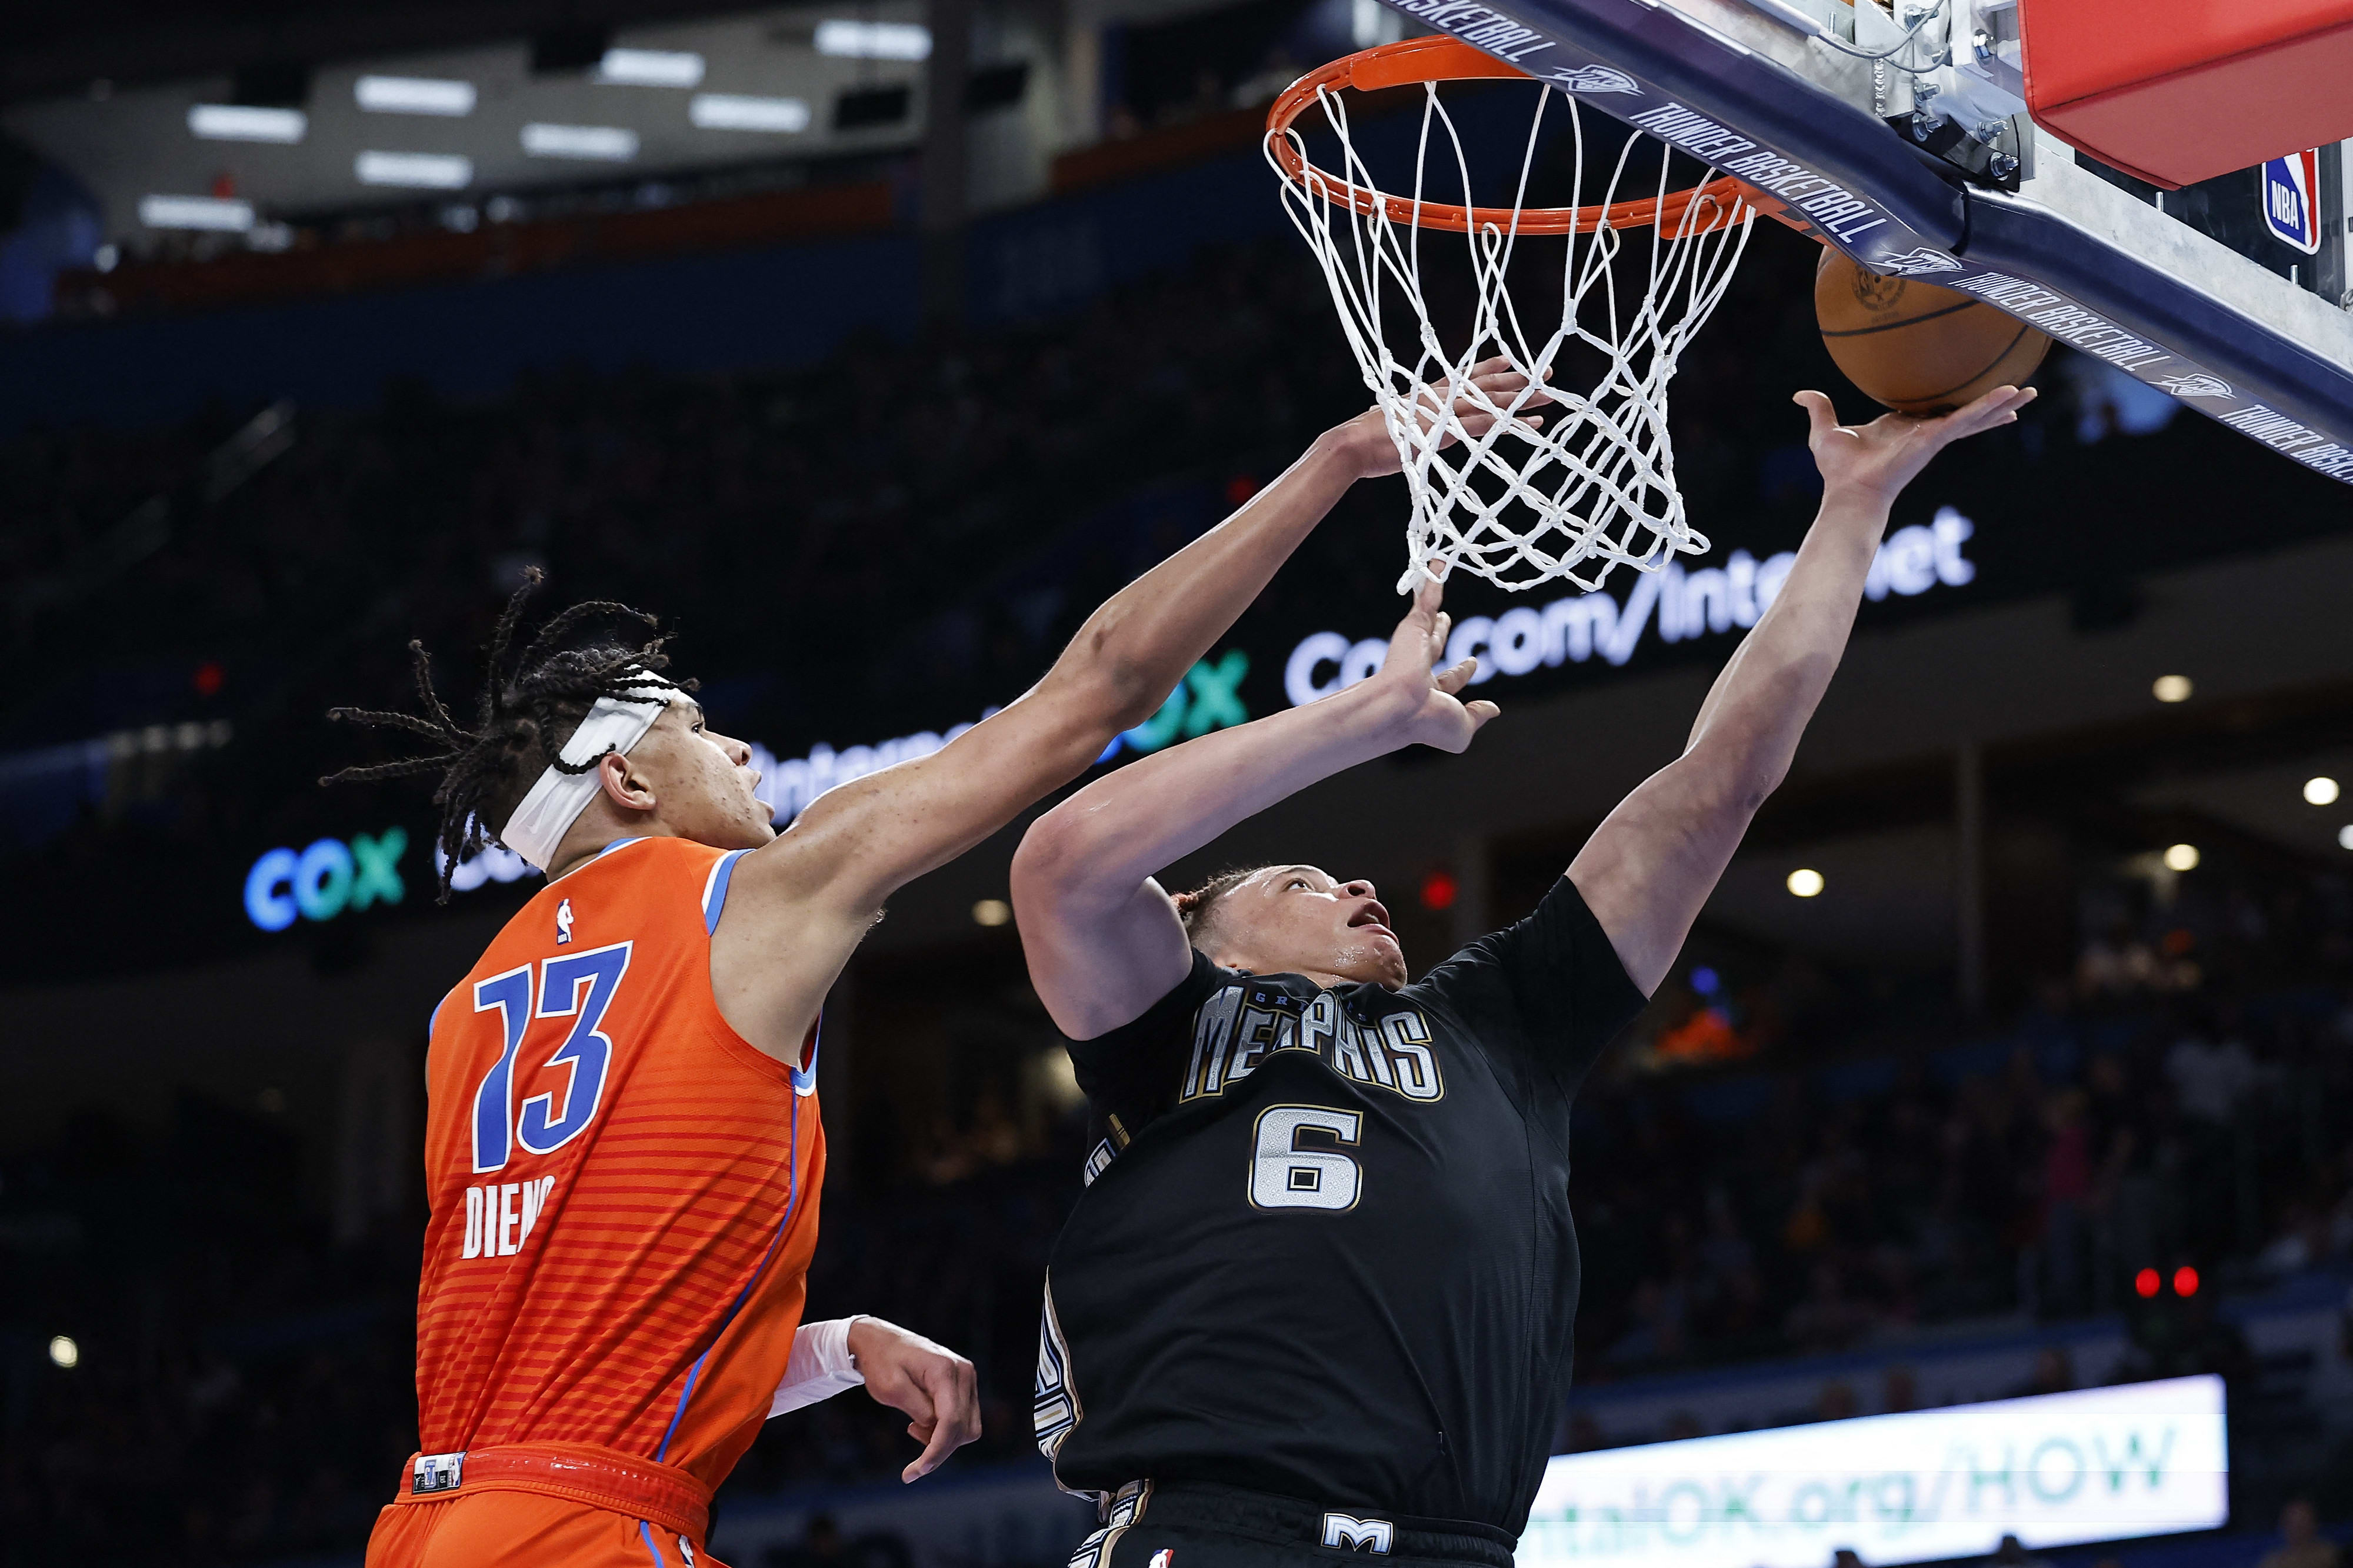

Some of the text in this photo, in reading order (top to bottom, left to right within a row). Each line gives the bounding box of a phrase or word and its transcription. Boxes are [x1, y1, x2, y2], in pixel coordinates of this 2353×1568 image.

[1389, 0, 1557, 62] SKETBALL
[1628, 102, 1888, 243] THUNDER BASKETBALL
[2271, 179, 2299, 231] NBA
[1947, 271, 2062, 312] THUNDER
[2025, 304, 2171, 372] BASKETBALL
[2217, 403, 2353, 483] THUNDER BASK
[472, 940, 634, 1173] 13
[1247, 1103, 1364, 1214] 6
